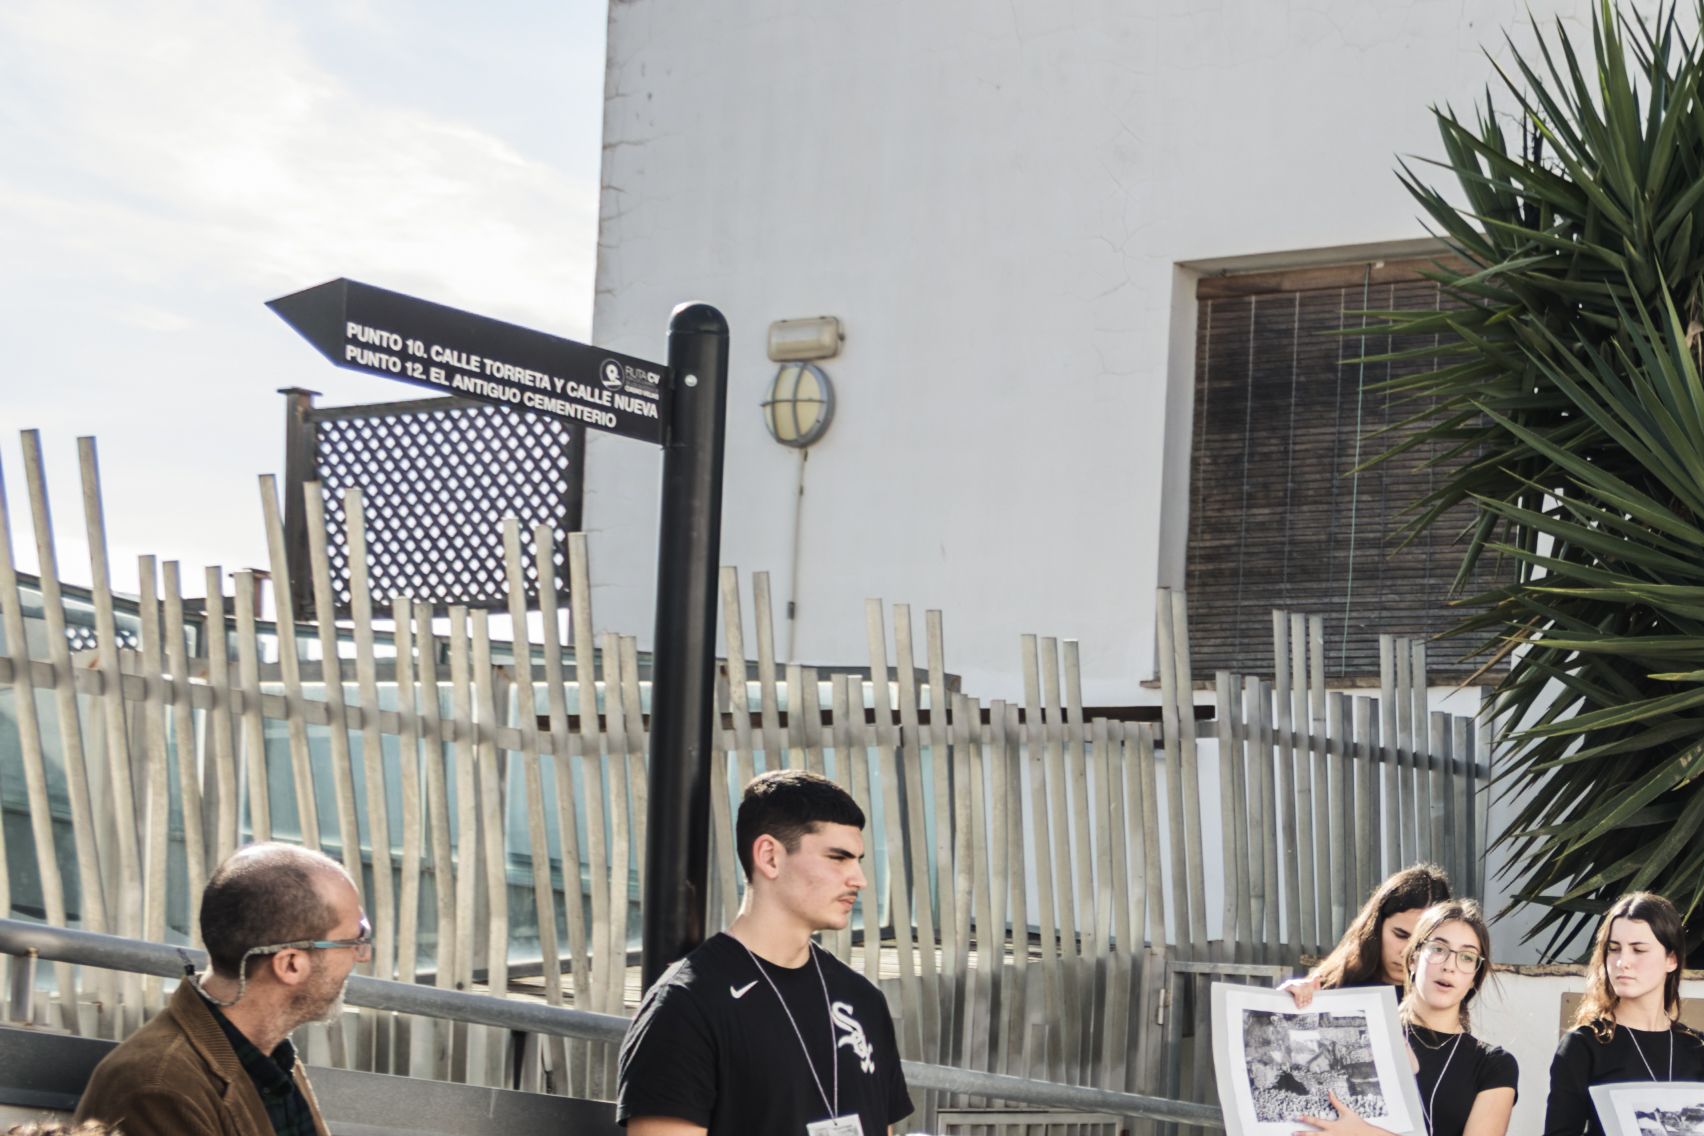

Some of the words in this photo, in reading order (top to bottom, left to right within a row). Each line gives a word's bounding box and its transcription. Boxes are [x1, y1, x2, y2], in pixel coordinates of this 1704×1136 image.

[345, 345, 402, 373] PUNTO
[405, 361, 427, 380] 12.
[429, 366, 450, 386] EL
[452, 374, 521, 404] ANTIGUO
[523, 391, 617, 428] CEMENTERIO
[346, 321, 403, 351] PUNTO
[406, 339, 428, 358] 10.
[430, 345, 481, 373] CALLE
[484, 358, 551, 391] TORRETA
[554, 376, 565, 394] Y
[566, 381, 613, 407] CALLE
[614, 393, 659, 419] NUEVA
